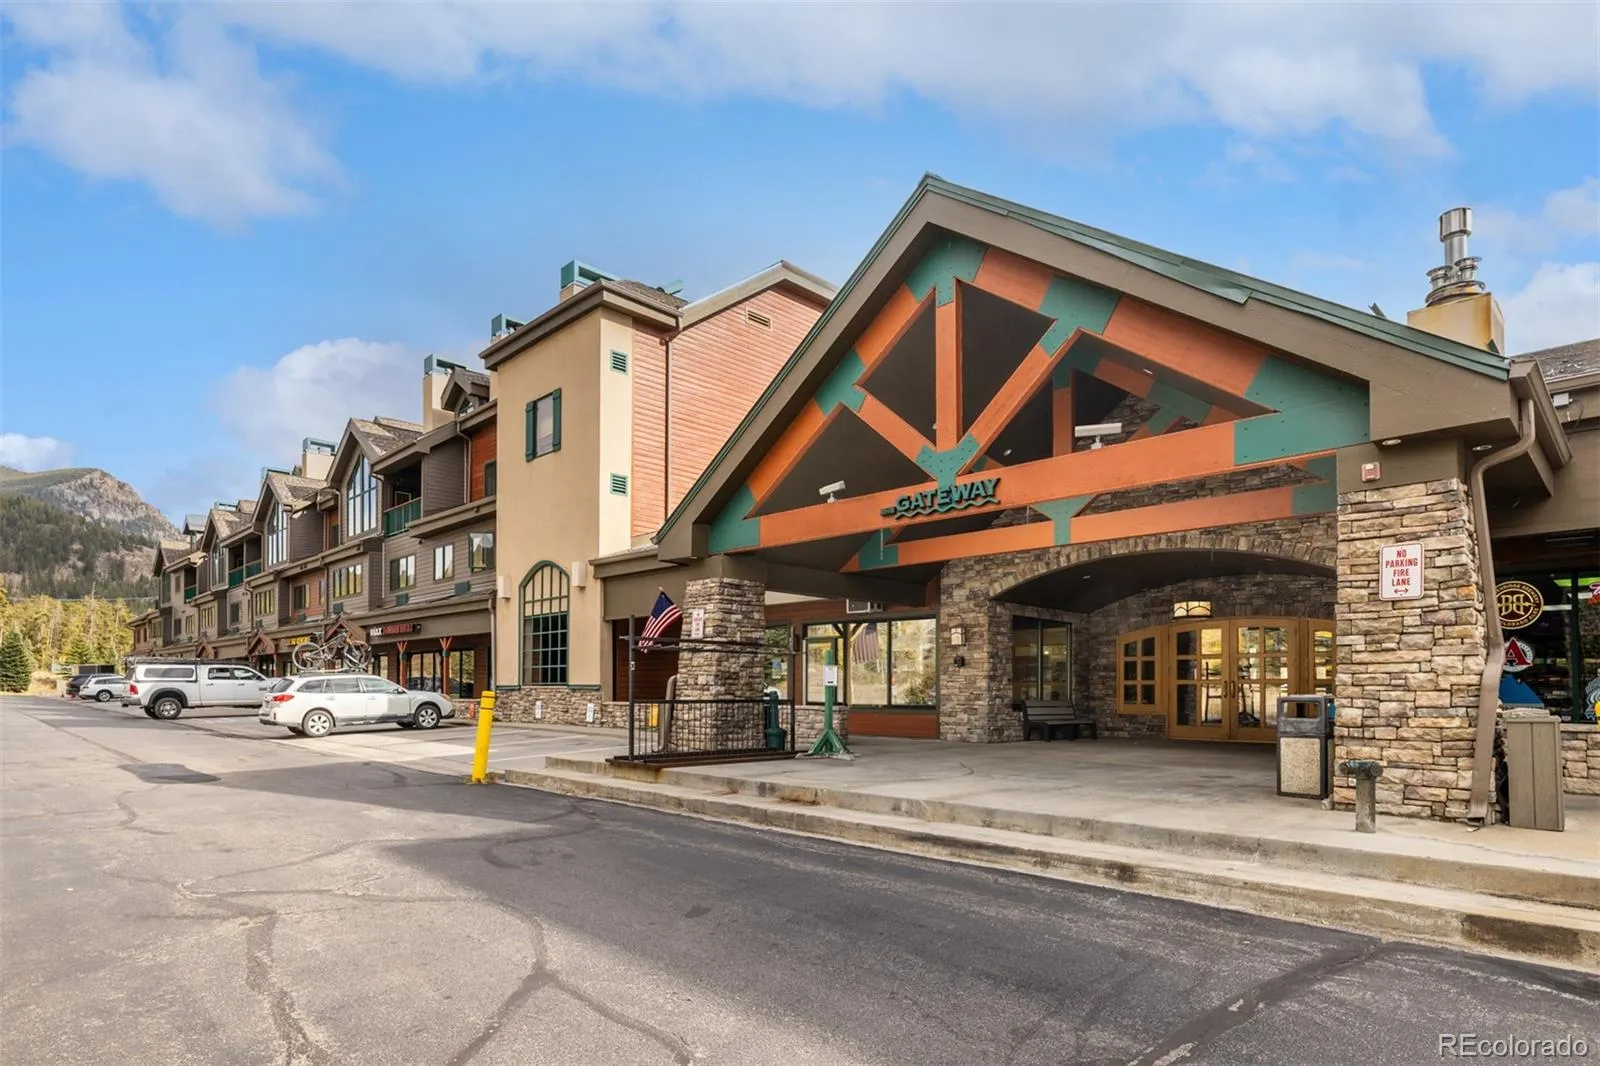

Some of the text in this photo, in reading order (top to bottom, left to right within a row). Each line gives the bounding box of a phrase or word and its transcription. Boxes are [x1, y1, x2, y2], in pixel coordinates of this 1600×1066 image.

[895, 478, 1000, 512] GATEWAY
[1396, 549, 1407, 558] NO
[1385, 558, 1418, 568] PARKING
[1393, 568, 1410, 577] FIRE
[1391, 578, 1411, 587] LANE
